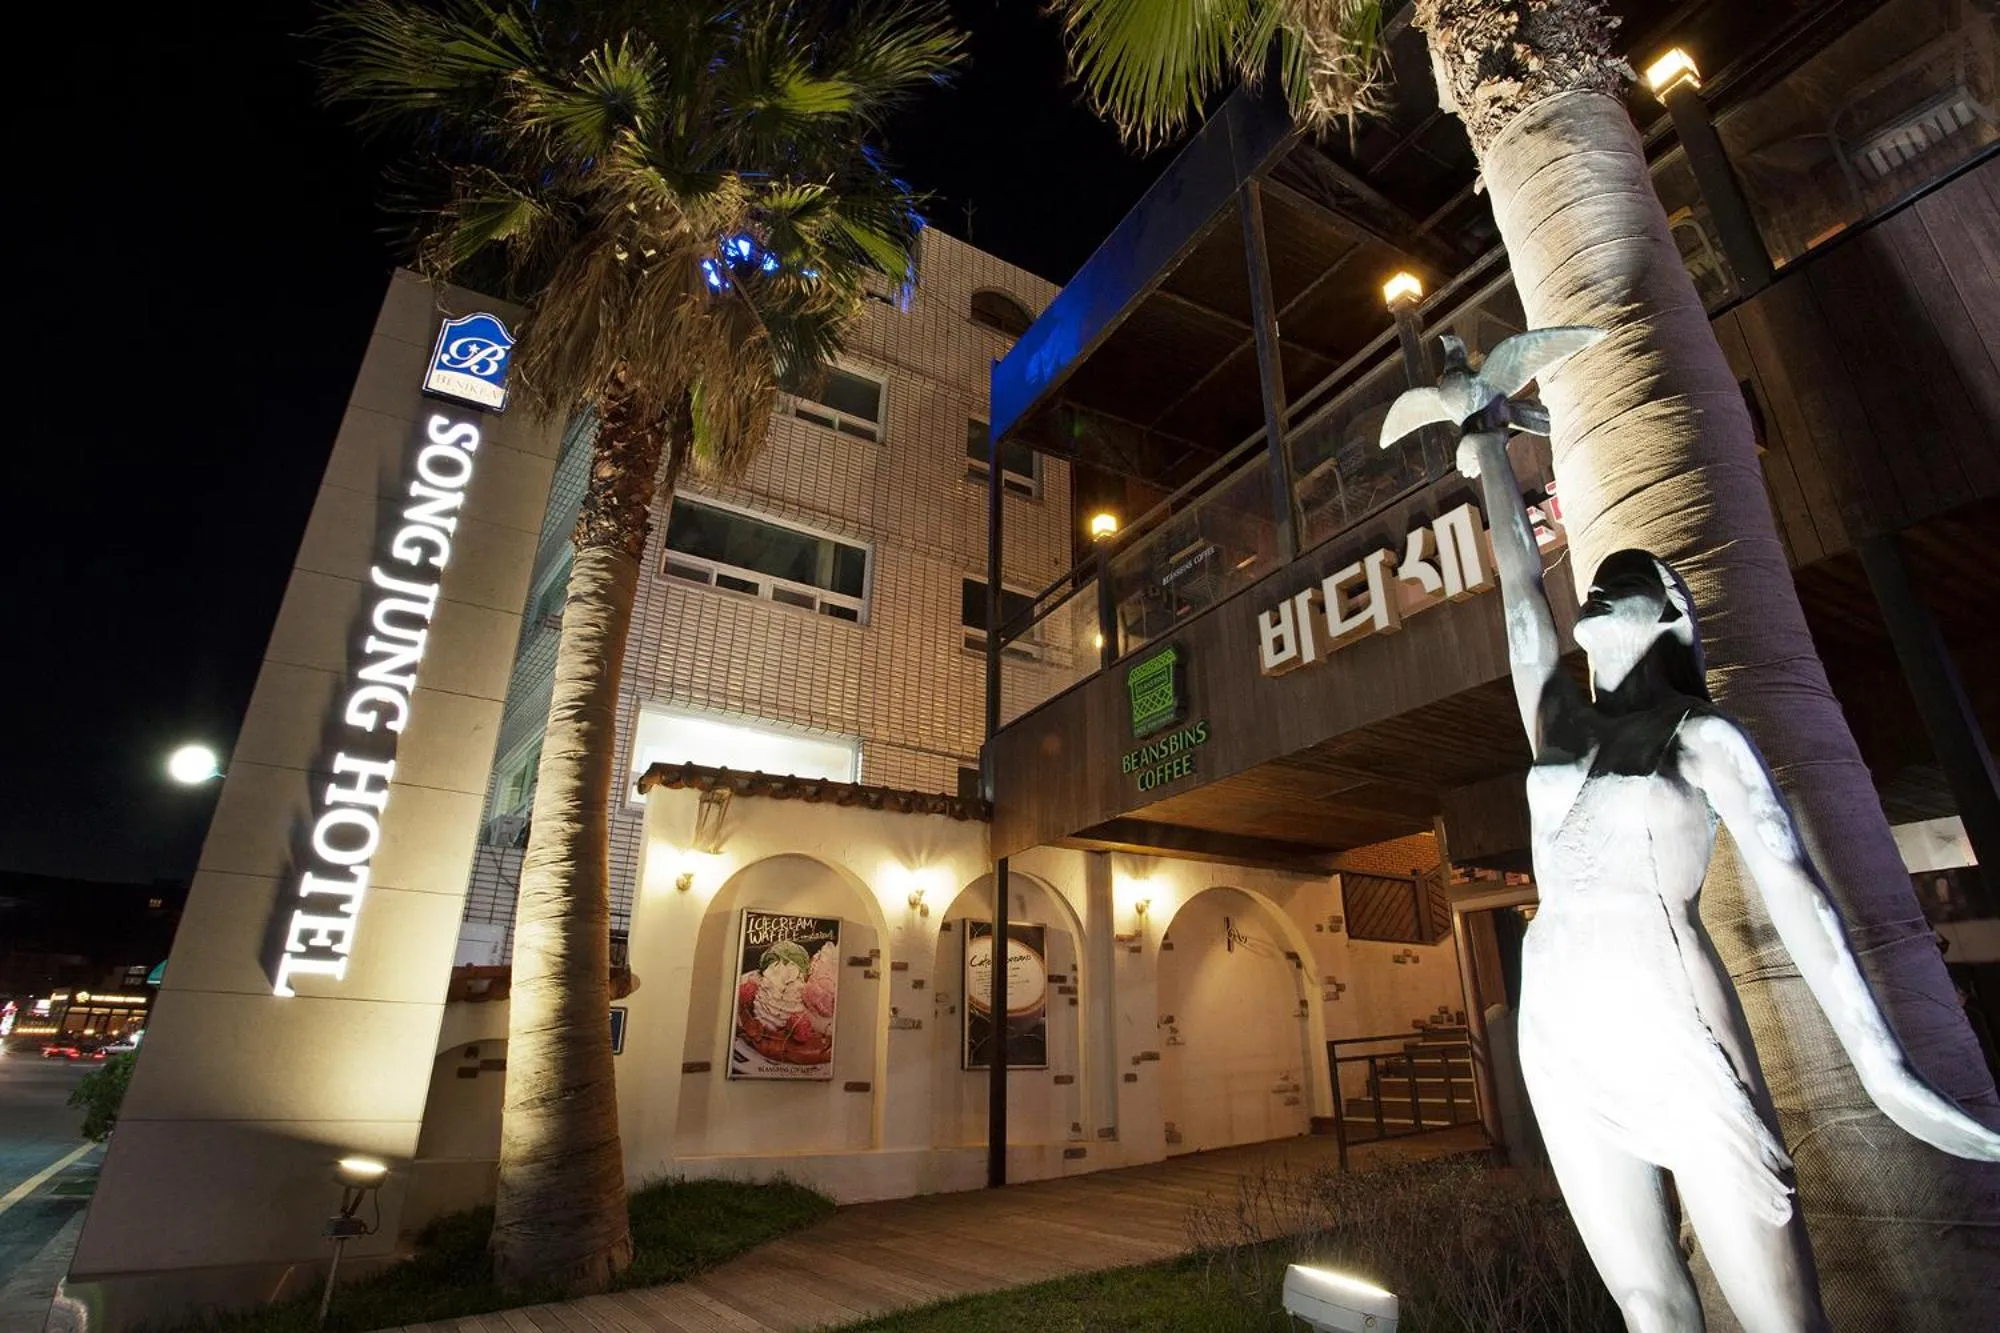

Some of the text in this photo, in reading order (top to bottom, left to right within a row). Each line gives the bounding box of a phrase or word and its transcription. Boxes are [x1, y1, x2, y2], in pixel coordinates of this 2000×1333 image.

[1258, 502, 1489, 673] 바다새
[1122, 721, 1207, 774] BEANSBINS
[1137, 754, 1193, 792] COFFEE
[273, 752, 396, 998] HOTEL
[750, 929, 800, 944] WAFFLE
